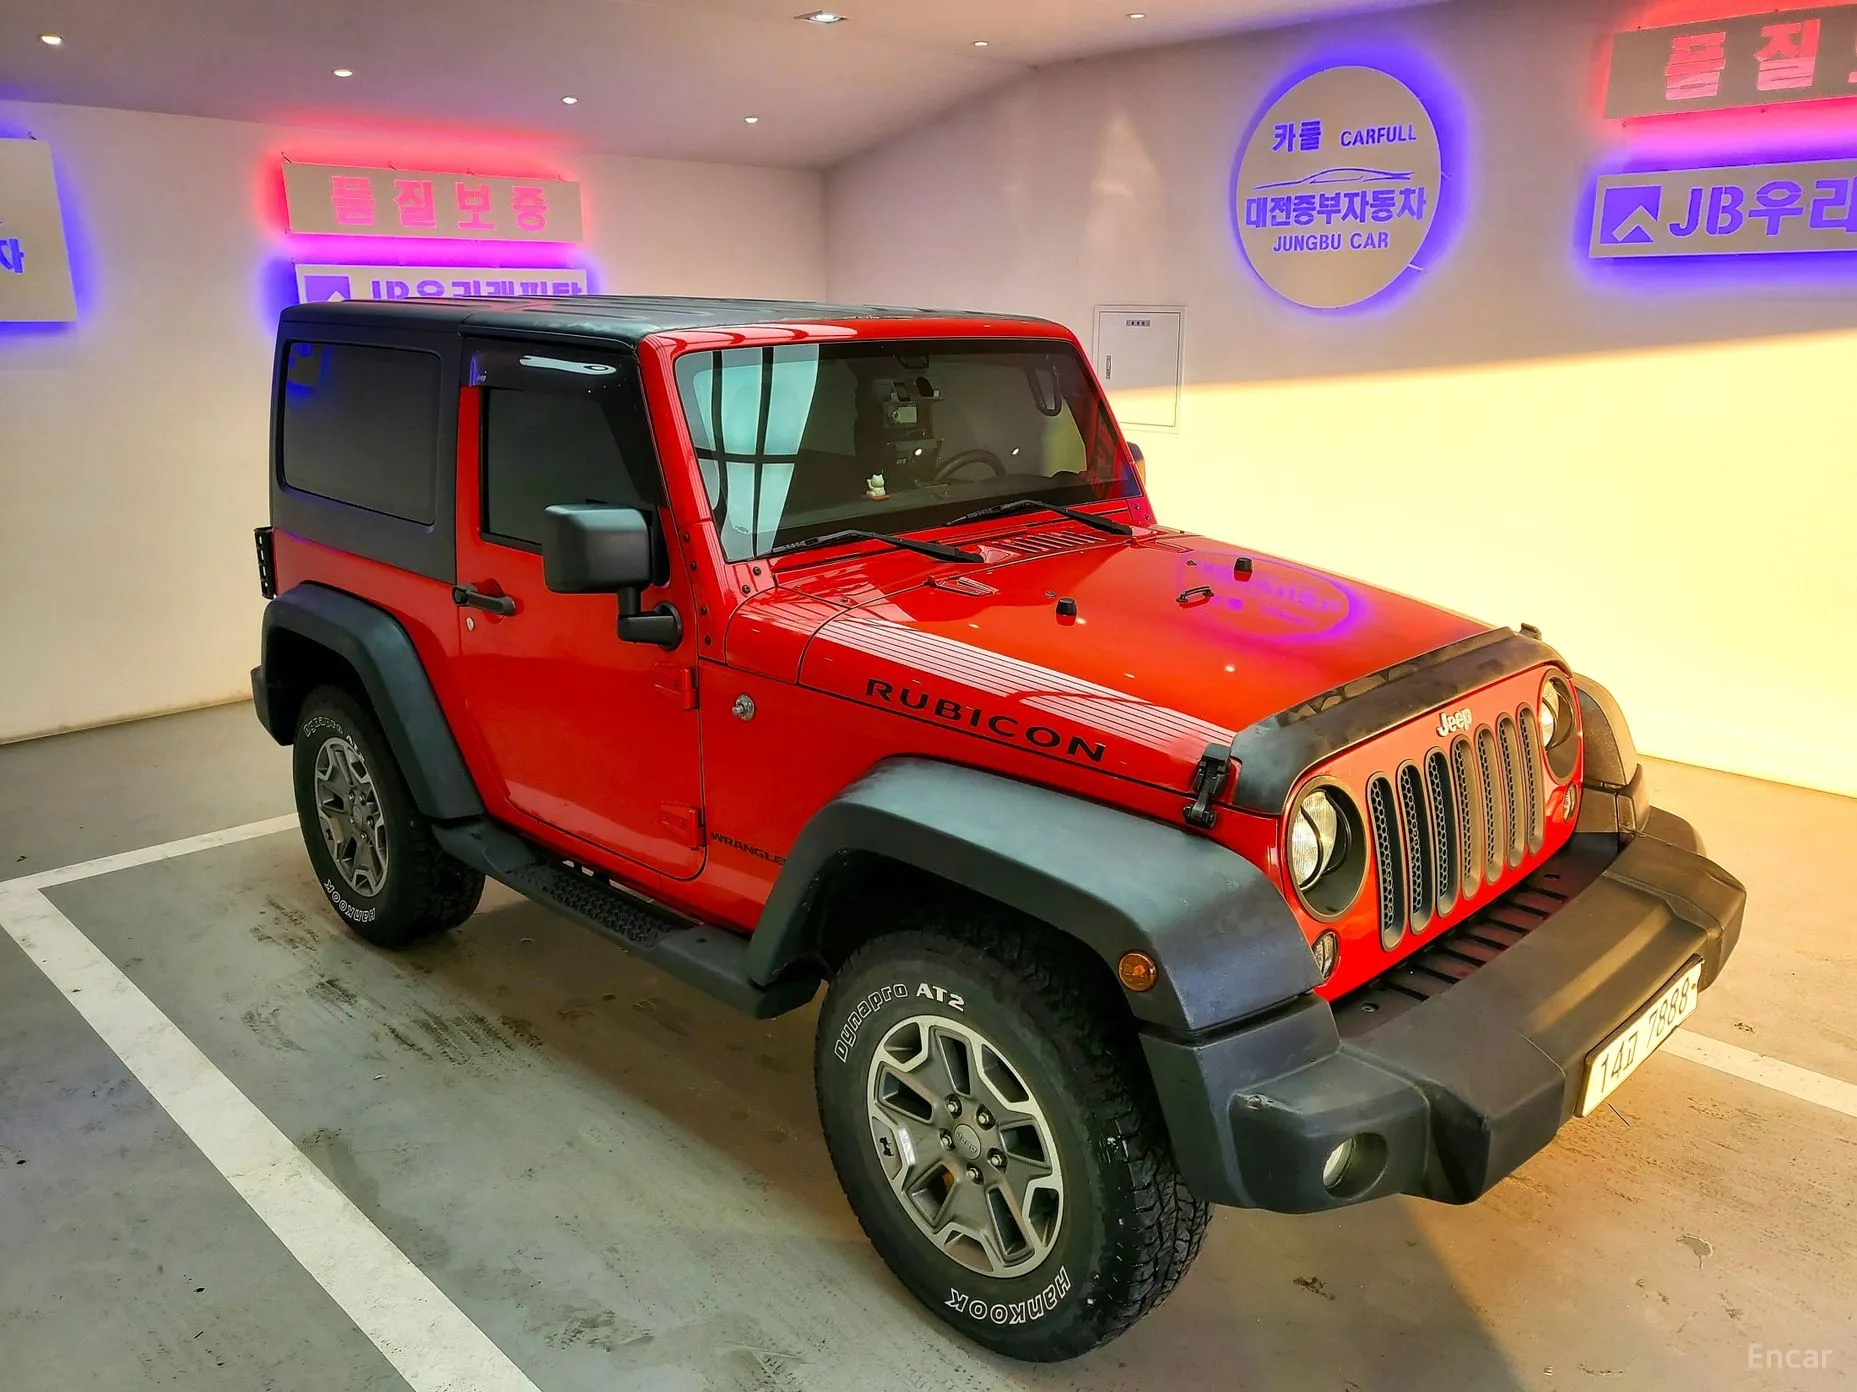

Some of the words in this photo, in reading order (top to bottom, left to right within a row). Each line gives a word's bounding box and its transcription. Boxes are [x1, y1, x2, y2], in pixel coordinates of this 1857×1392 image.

[1664, 18, 1857, 101] 품질
[1272, 121, 1322, 152] 카풀
[1340, 124, 1417, 147] CARFULL
[1245, 187, 1427, 228] 대전중부자동차
[1272, 233, 1342, 252] JUNGBU
[1350, 232, 1389, 250] CAR
[864, 678, 1106, 763] RUBICON
[1436, 707, 1472, 737] Jeep
[834, 983, 909, 1063] Dynapro
[916, 982, 965, 1012] AT2
